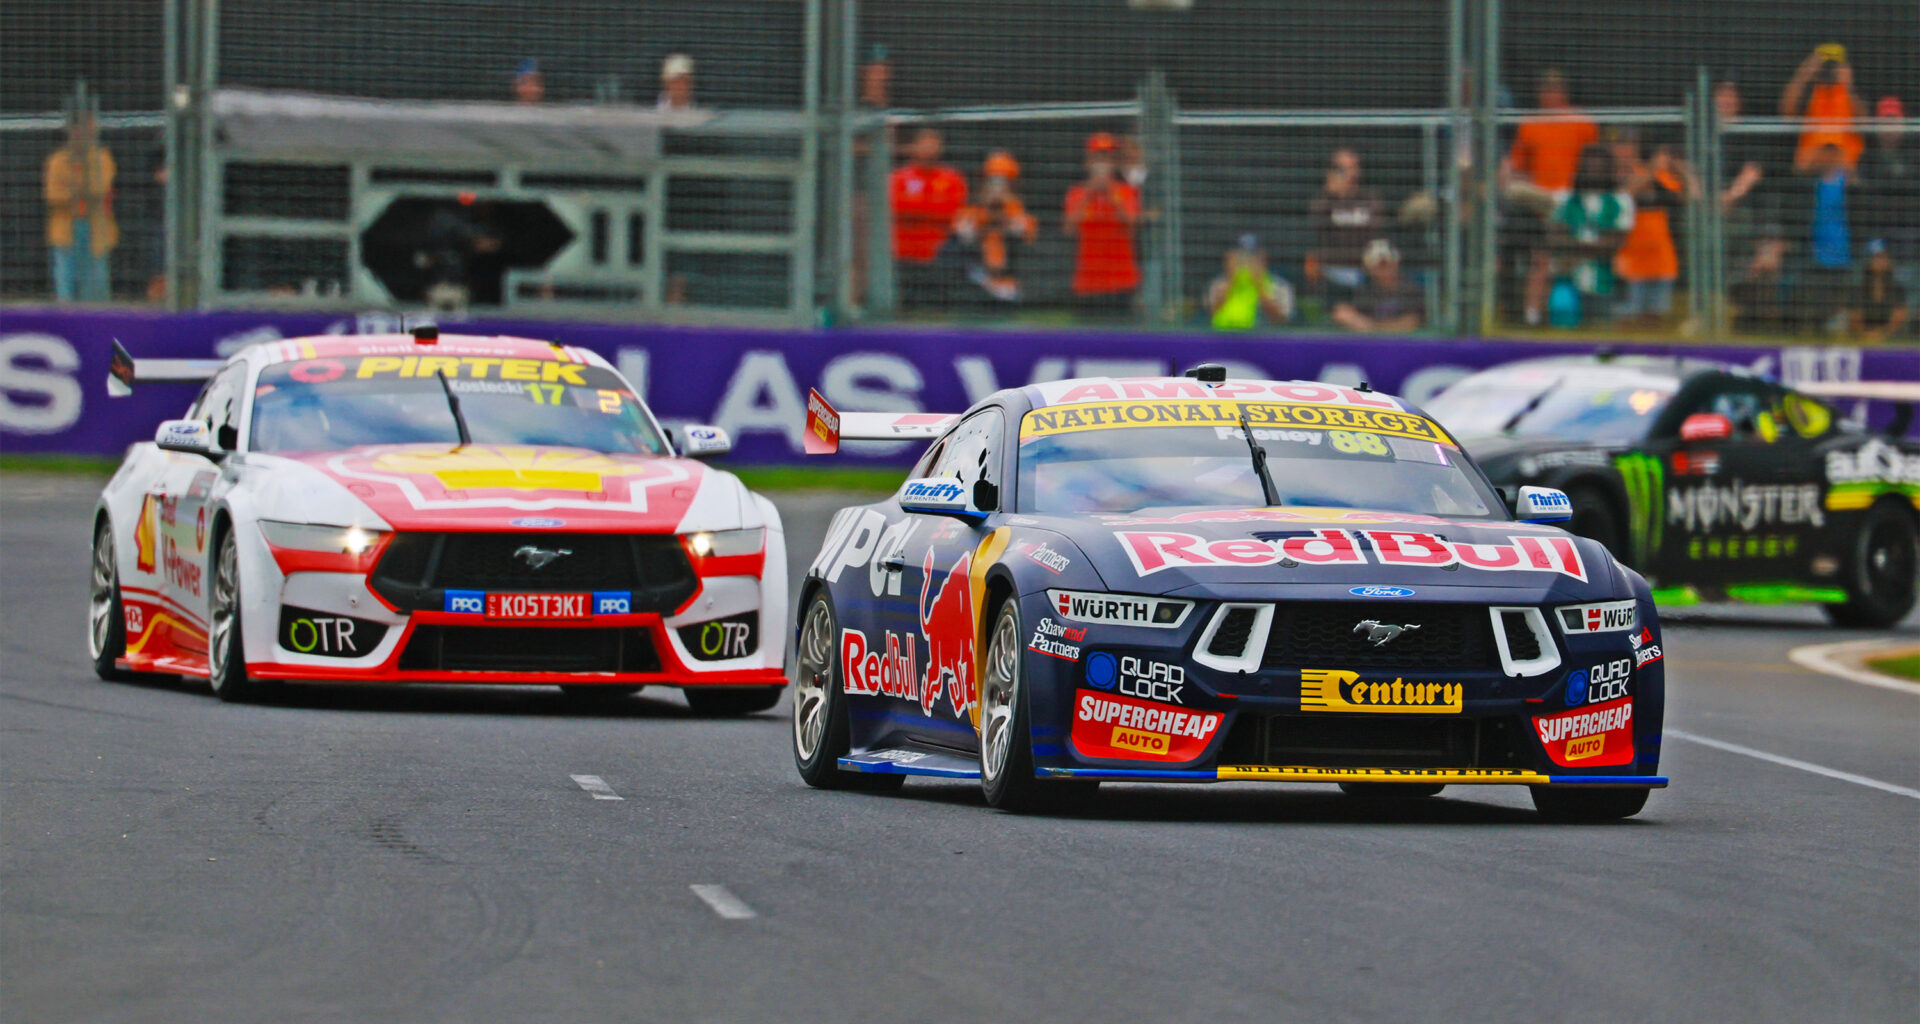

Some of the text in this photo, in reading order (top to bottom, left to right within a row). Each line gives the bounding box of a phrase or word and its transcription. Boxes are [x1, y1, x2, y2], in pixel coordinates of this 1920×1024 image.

[356, 356, 587, 385] PIRTEK
[450, 378, 565, 406] Kostecki 17
[614, 345, 922, 457] LAS
[1057, 382, 1394, 409] AMPOL
[808, 393, 839, 435] SUPERCHEAP
[1030, 403, 1429, 437] NATIONAL STORAGE
[1216, 427, 1388, 456] Feeney 88
[905, 482, 964, 501] Thrifty
[1667, 479, 1826, 532] MONSTER
[1114, 529, 1588, 583] Red Bull
[452, 598, 482, 612] PPQ
[600, 599, 629, 613] PPQ
[1362, 587, 1402, 596] Ford
[1072, 598, 1147, 622] WÜRTH
[290, 617, 357, 652] OTR
[701, 621, 749, 657] OTR
[1028, 632, 1081, 660] Partners
[1120, 656, 1185, 685] QUAD
[1590, 659, 1631, 685] QUAD
[1119, 674, 1184, 704] LOCK
[1301, 669, 1463, 713] Century
[1588, 676, 1629, 704] LOCK
[1079, 695, 1217, 740] SUPERCHEAP
[1538, 703, 1632, 743] SUPERCHEAP
[1116, 732, 1164, 751] AUTO
[1569, 739, 1600, 757] AUTO
